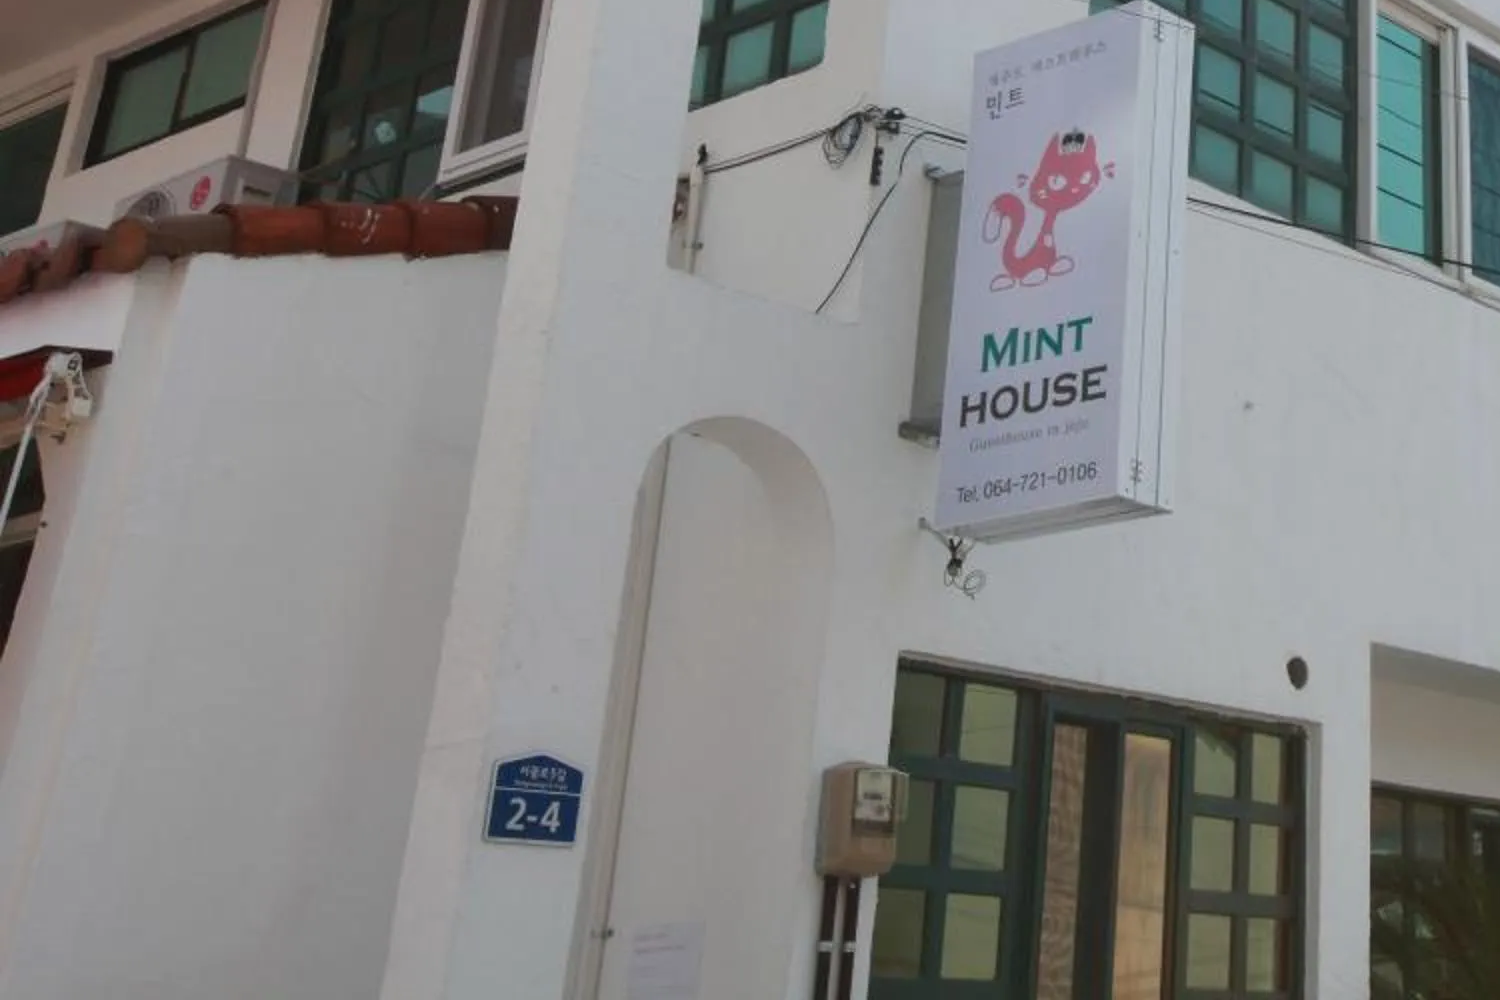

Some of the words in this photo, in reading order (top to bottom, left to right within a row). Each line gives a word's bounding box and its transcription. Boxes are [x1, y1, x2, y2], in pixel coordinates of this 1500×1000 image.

[986, 87, 1025, 121] 민트
[980, 316, 1093, 373] MINT
[959, 364, 1107, 428] HOUSE
[983, 461, 1097, 499] 064-721-0106
[505, 797, 561, 833] 2-4
